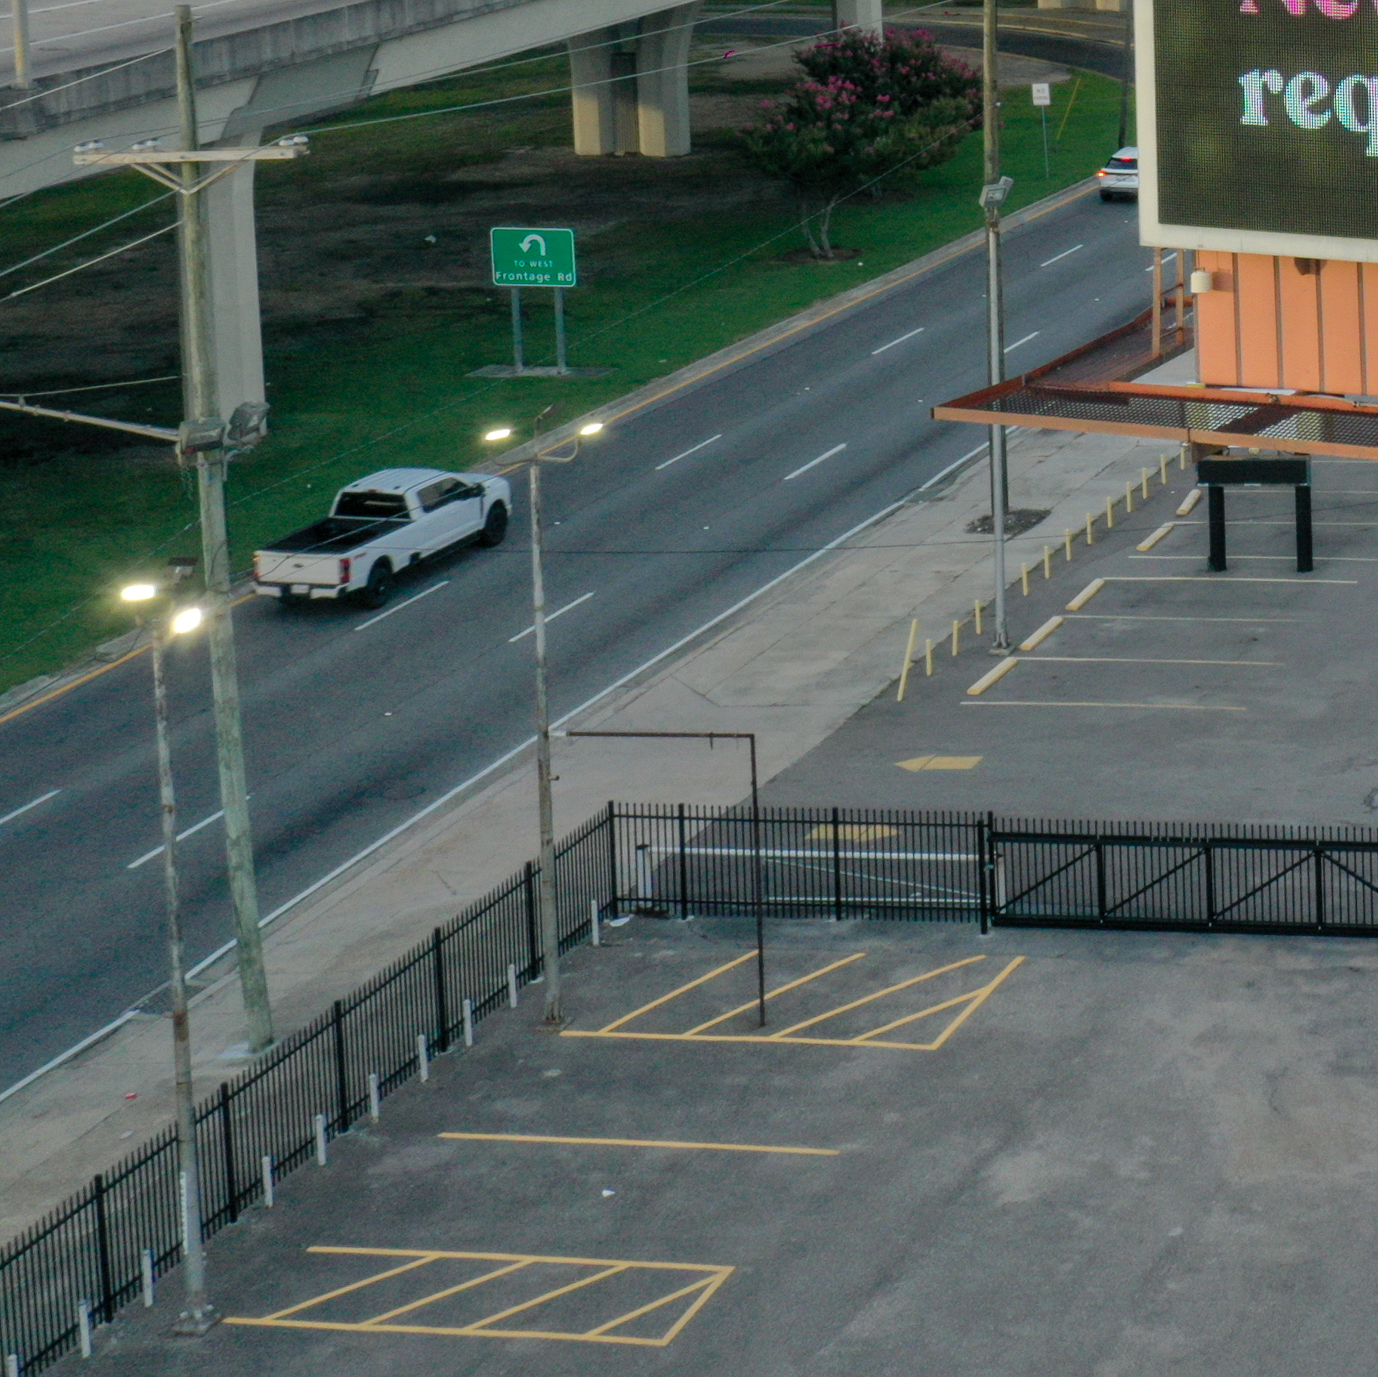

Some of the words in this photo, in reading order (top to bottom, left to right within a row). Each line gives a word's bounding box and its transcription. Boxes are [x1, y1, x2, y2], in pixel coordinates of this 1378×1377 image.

[513, 260, 525, 268] TO
[529, 260, 553, 268] WEST
[495, 271, 551, 284] Frontage
[557, 272, 573, 282] Rd
